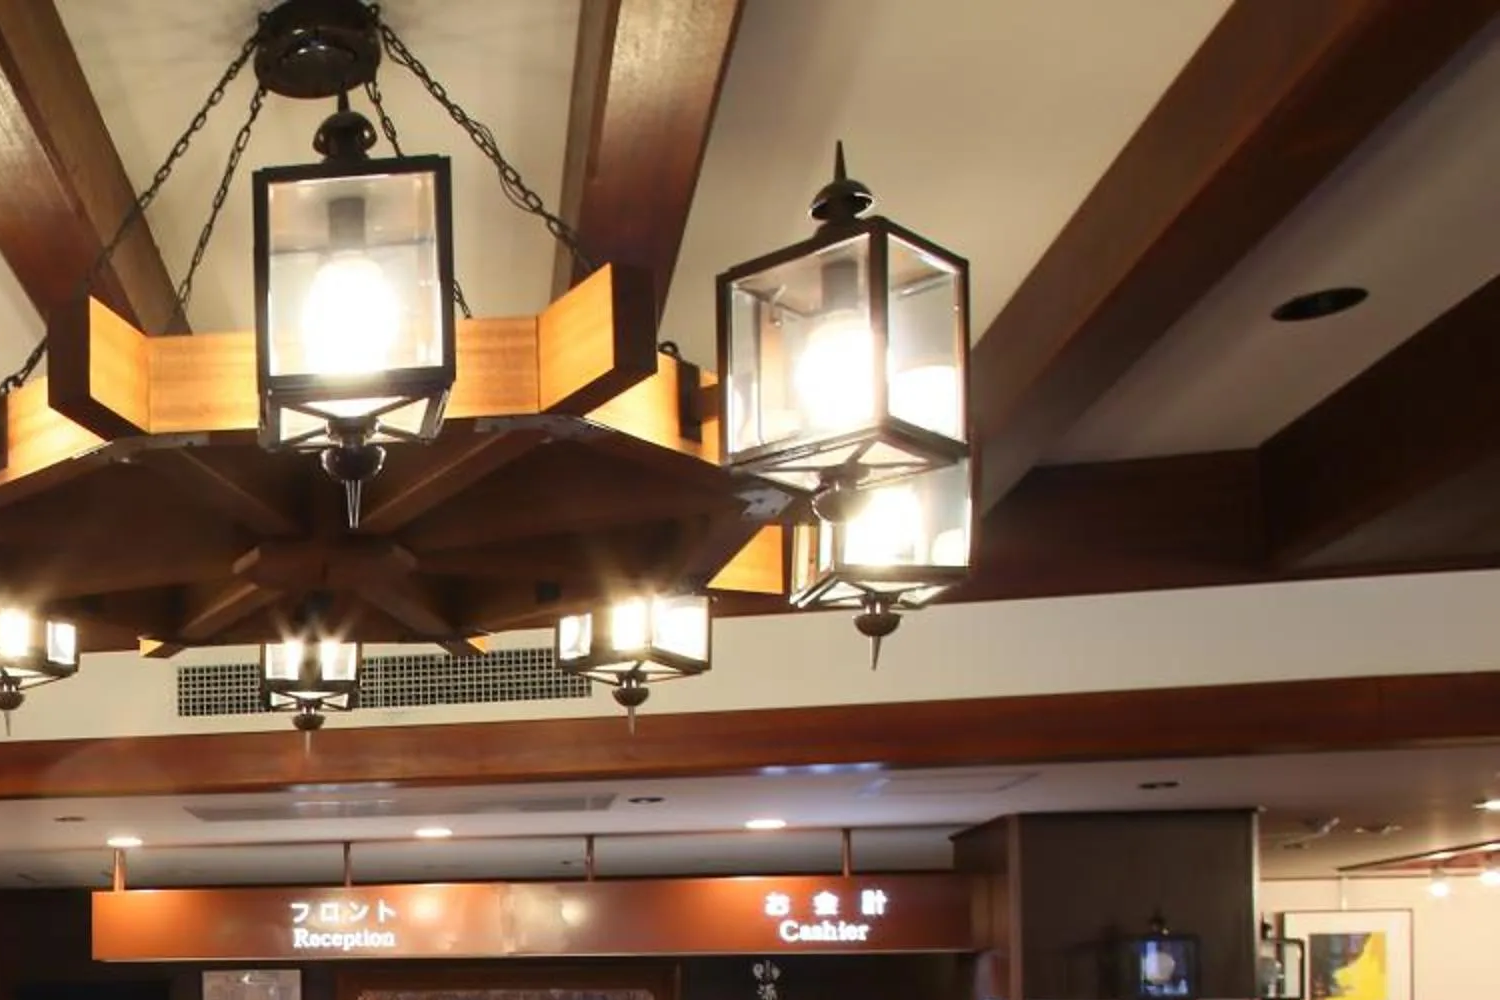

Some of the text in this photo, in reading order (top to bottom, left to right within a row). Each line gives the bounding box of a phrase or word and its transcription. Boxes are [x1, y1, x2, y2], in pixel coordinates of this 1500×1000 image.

[290, 899, 397, 924] フロント
[293, 927, 396, 951] Reception
[779, 919, 870, 942] Cashier
